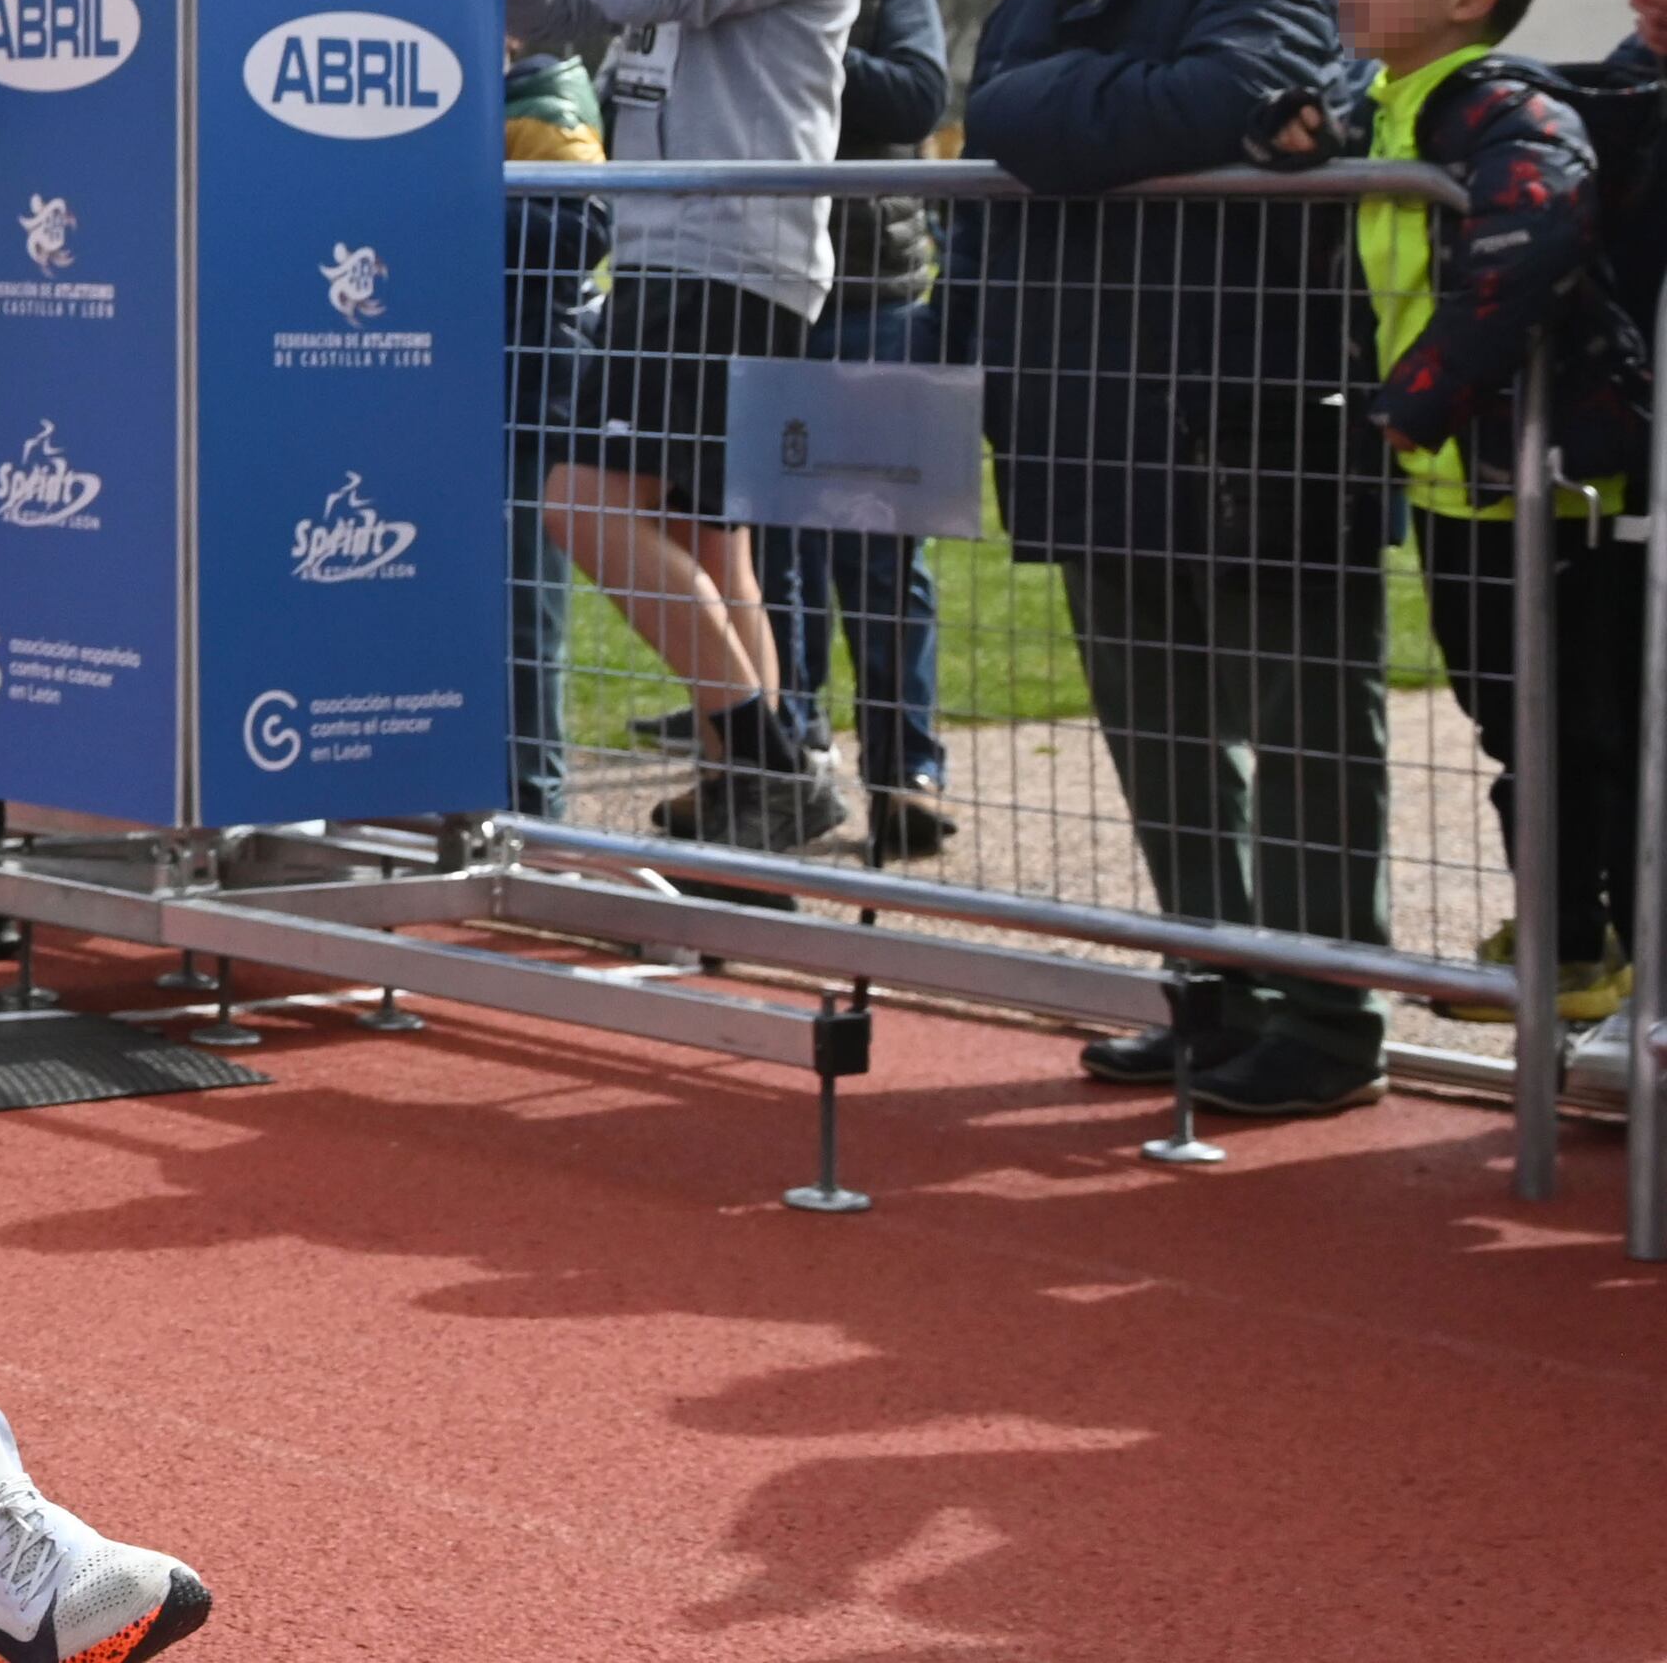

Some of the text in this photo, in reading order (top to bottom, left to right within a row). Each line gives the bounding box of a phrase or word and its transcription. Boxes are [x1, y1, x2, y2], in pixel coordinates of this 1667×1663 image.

[272, 36, 439, 109] ABRIL
[274, 350, 293, 367] DE
[300, 350, 373, 368] CASTILLA
